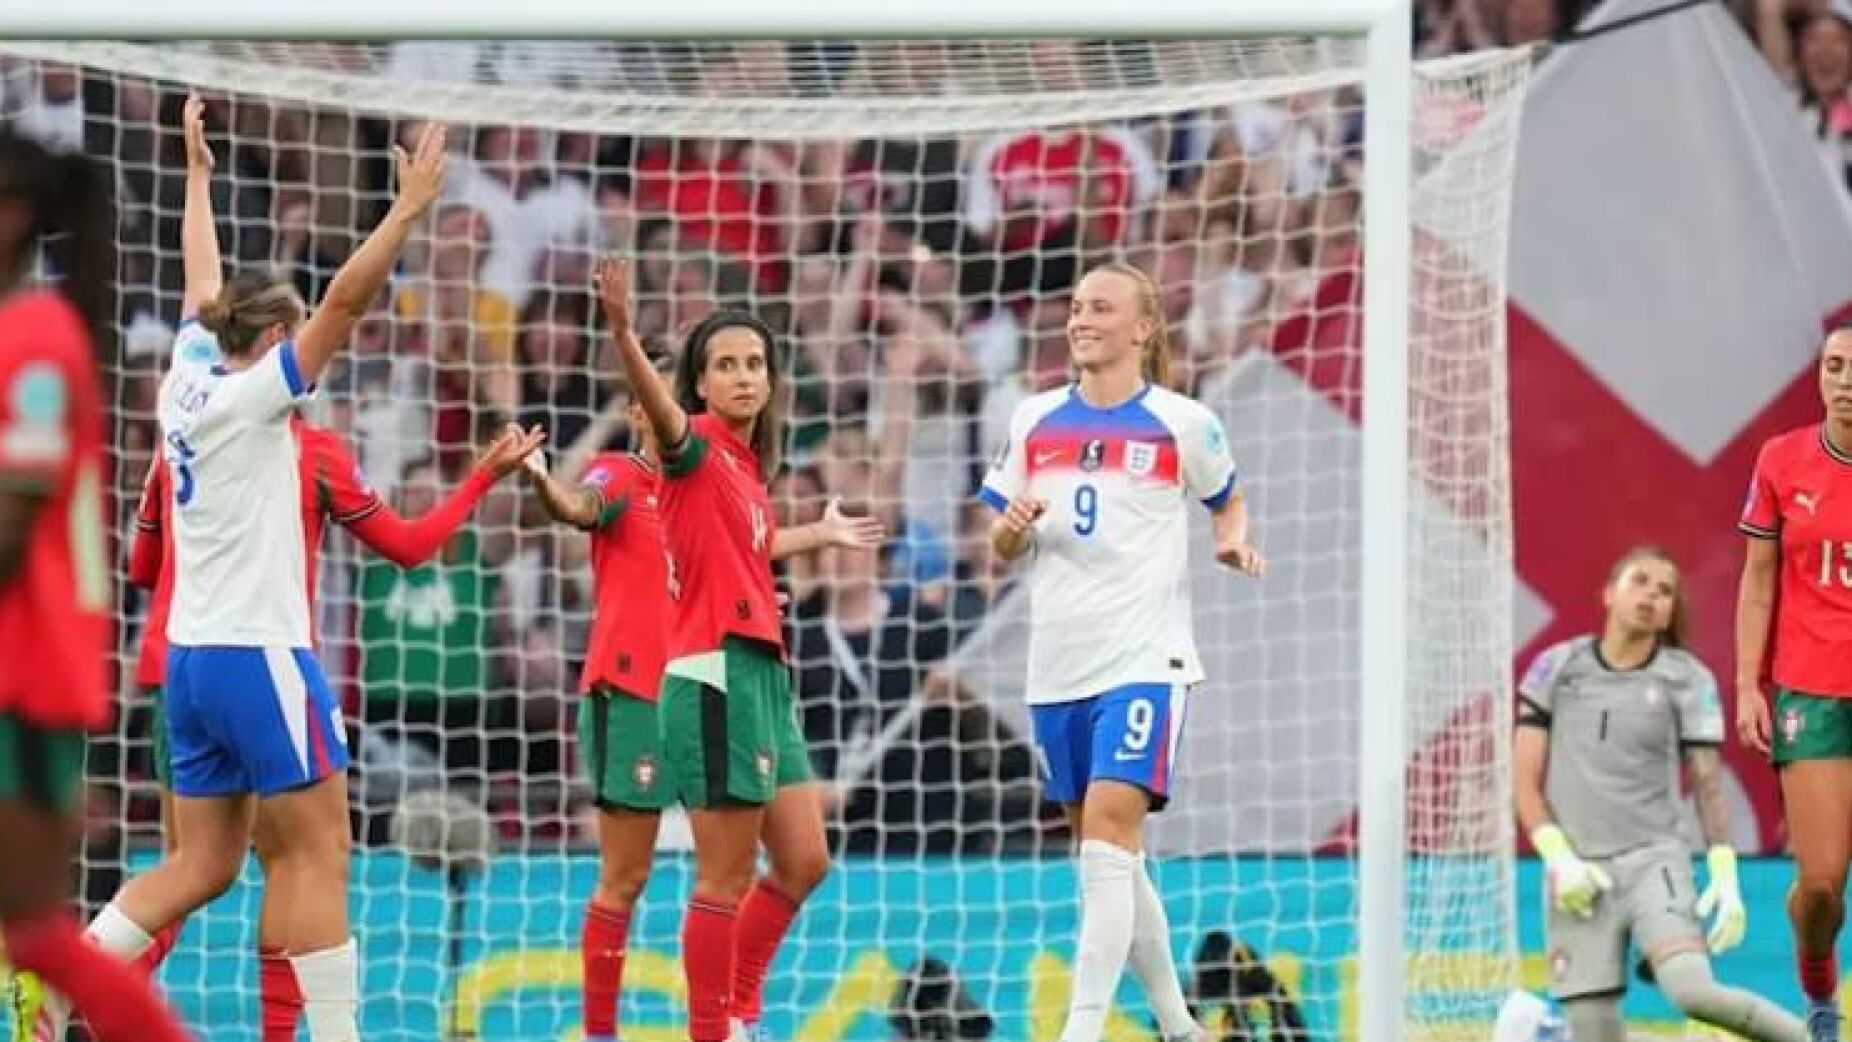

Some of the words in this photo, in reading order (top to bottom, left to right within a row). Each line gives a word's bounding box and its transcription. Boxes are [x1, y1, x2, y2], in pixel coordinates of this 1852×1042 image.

[1074, 483, 1098, 536] 9
[1125, 698, 1153, 749] 9
[1601, 709, 1608, 740] 1
[1662, 866, 1676, 897] 1
